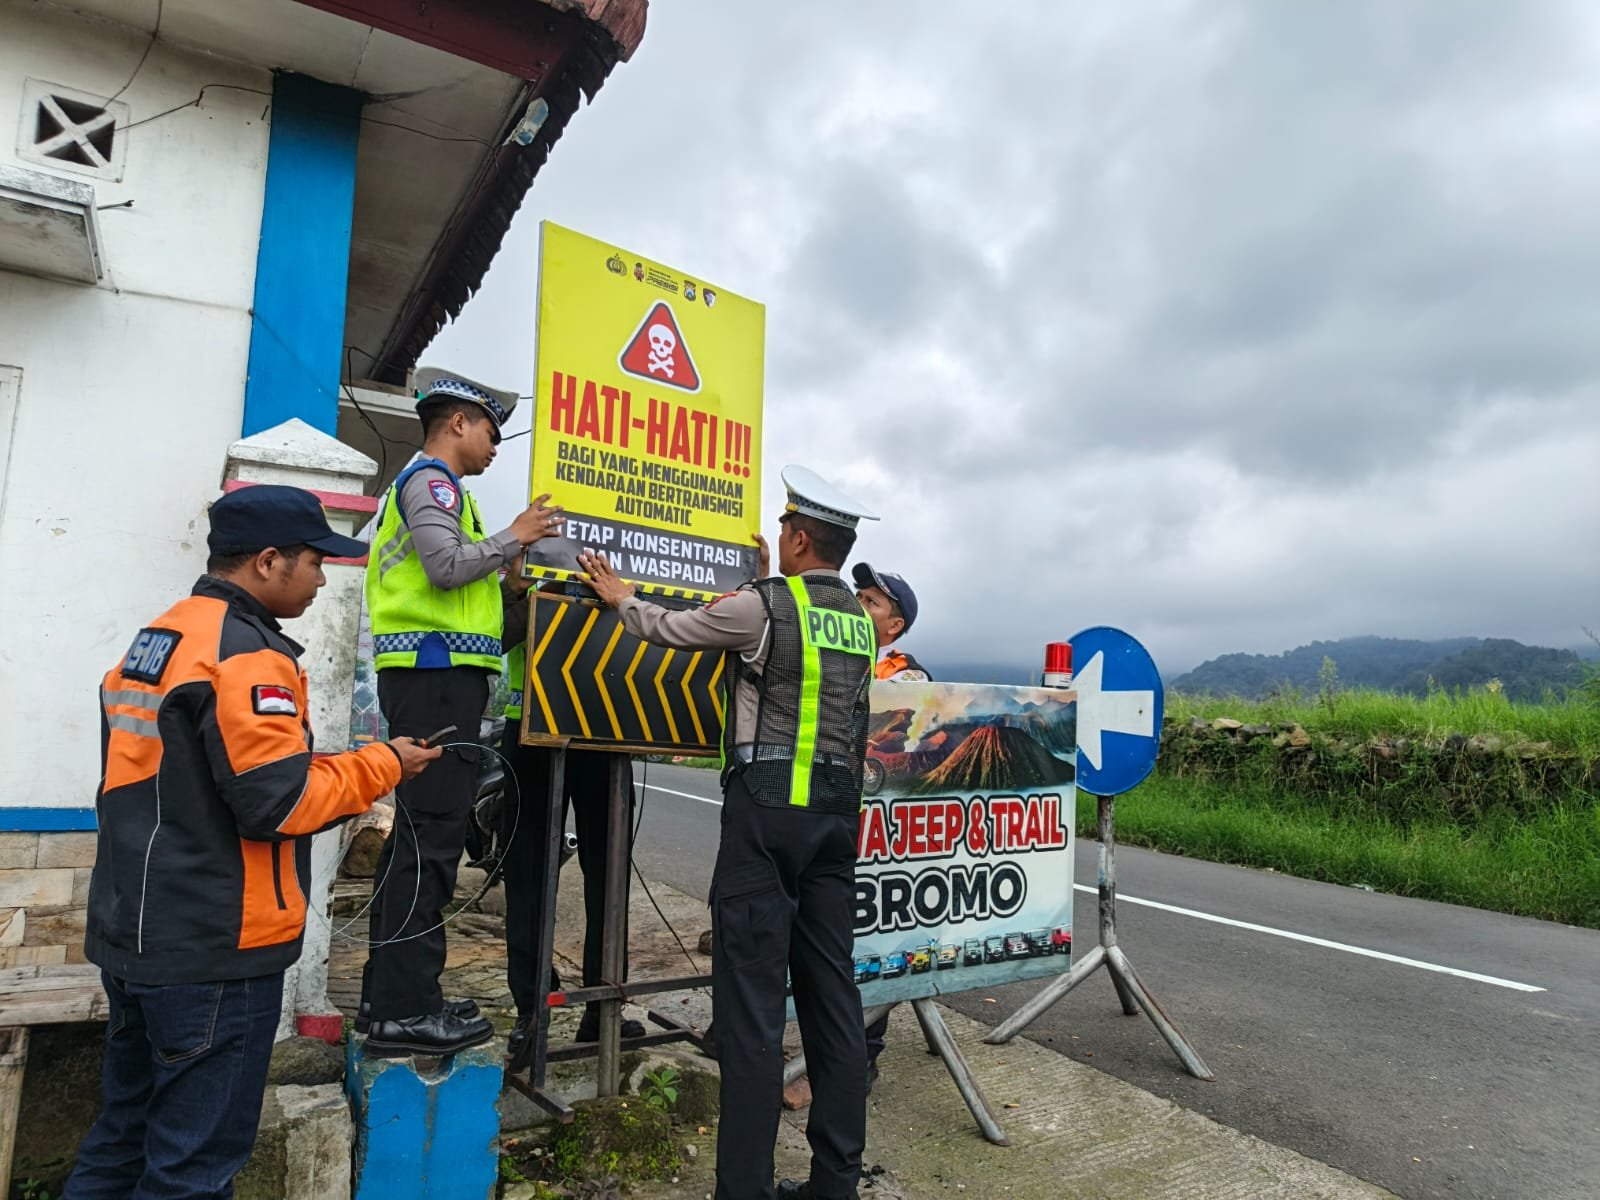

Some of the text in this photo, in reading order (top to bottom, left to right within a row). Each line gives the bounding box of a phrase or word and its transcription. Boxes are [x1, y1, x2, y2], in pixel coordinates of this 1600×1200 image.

[550, 371, 751, 478] HATI-HATI !!!
[556, 461, 744, 518] KENDARAAN BERTRANSMISI
[558, 441, 743, 500] BAGI YANG MENGGUNAKAN
[615, 495, 693, 527] AUTOMATIC
[621, 529, 741, 568] KONSENTRASI
[629, 554, 716, 586] WASPADA
[808, 610, 872, 654] POLISI
[891, 803, 963, 857] JEEP
[966, 802, 988, 852] &
[991, 800, 1064, 849] TRAIL
[855, 867, 1024, 931] BROMO
